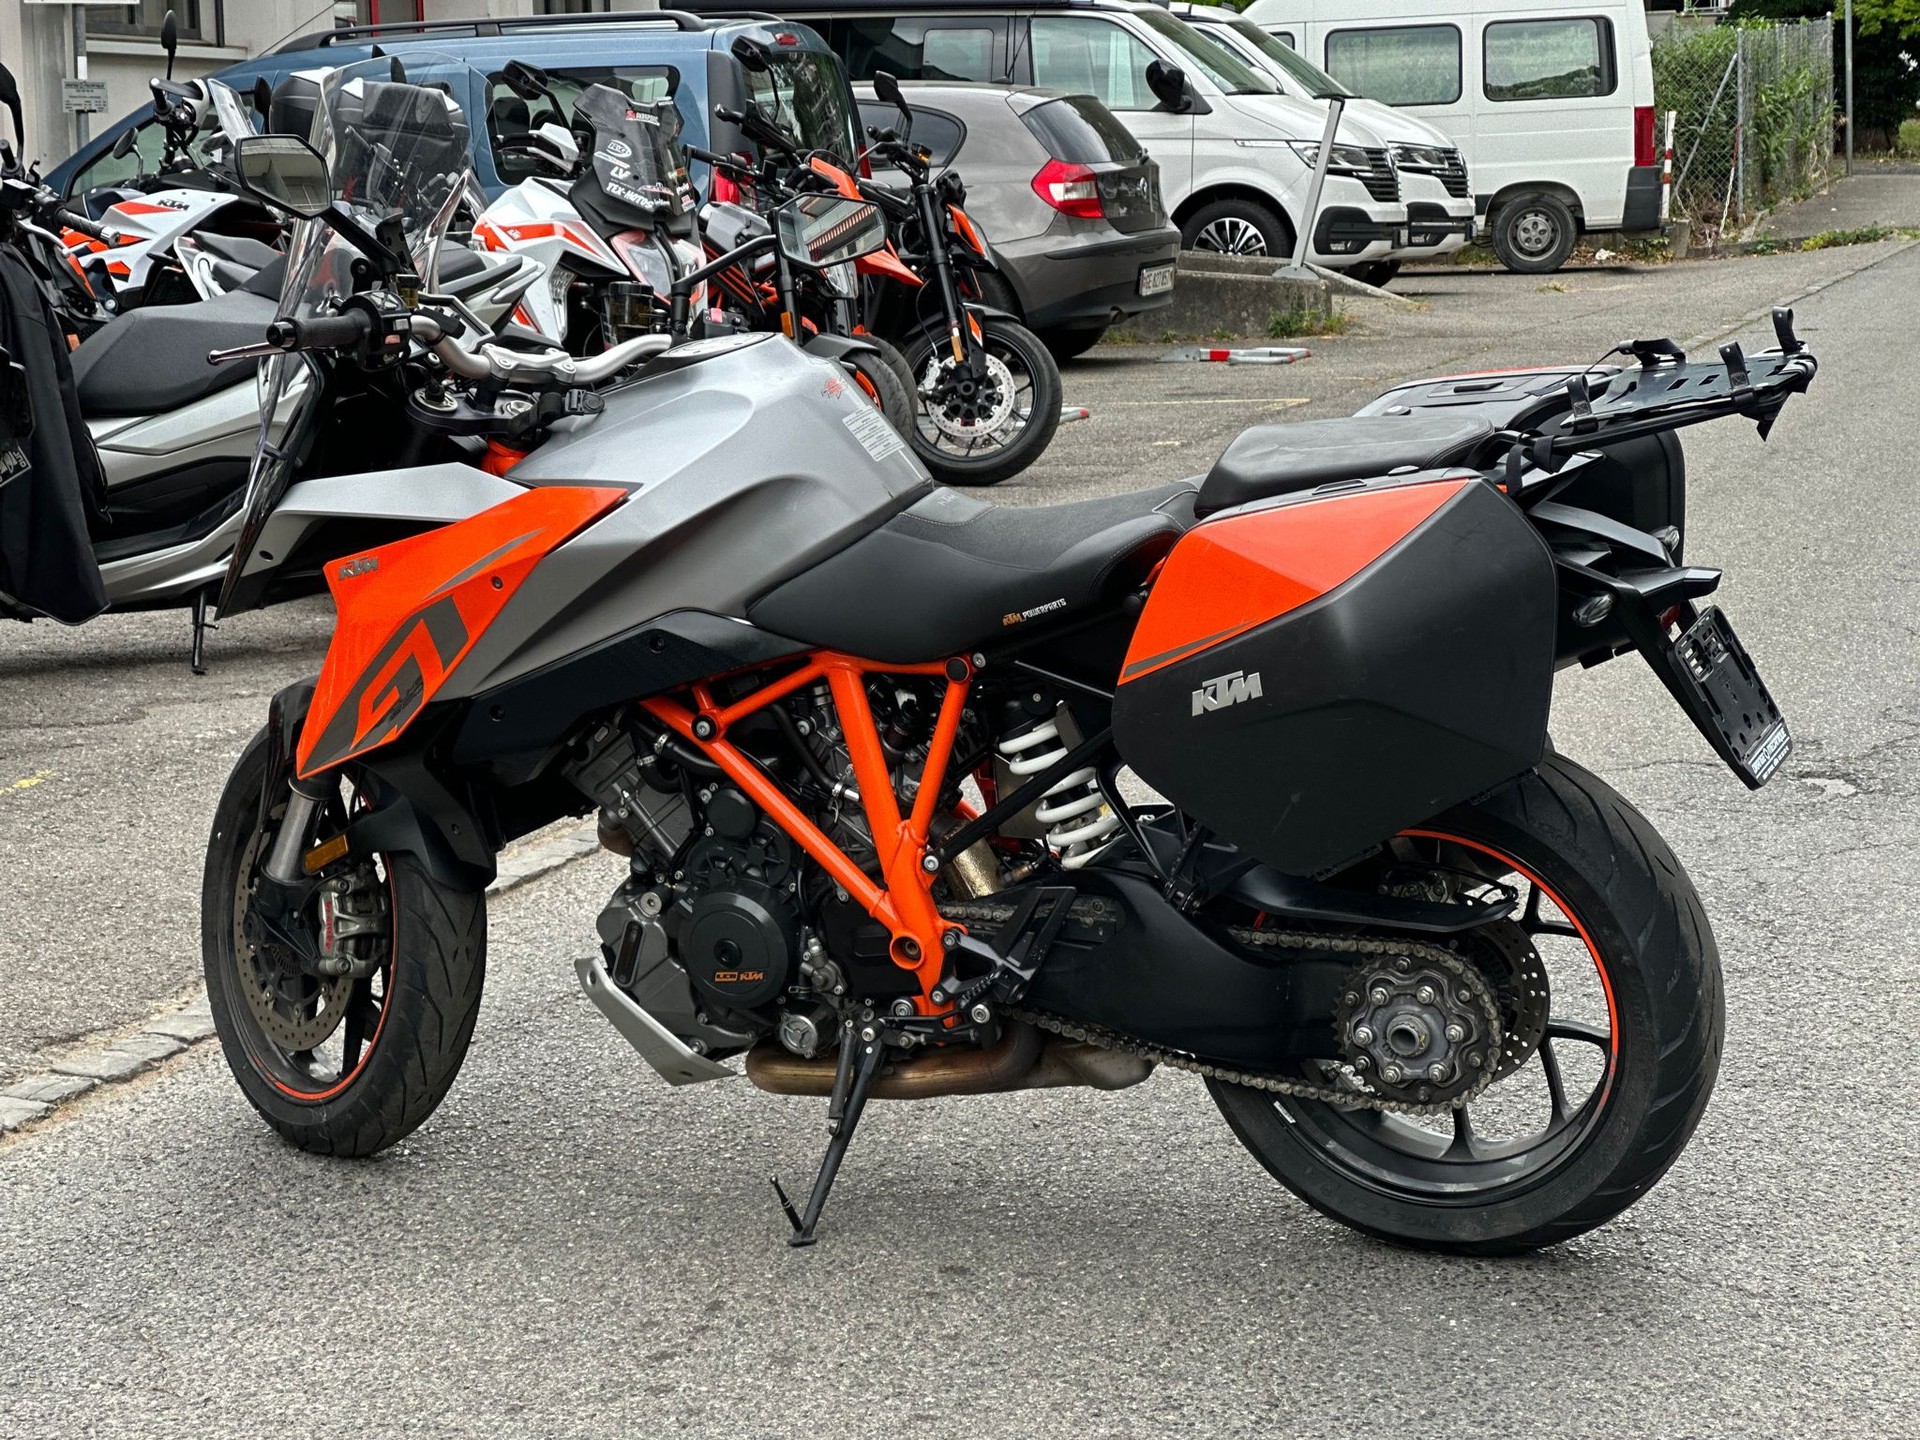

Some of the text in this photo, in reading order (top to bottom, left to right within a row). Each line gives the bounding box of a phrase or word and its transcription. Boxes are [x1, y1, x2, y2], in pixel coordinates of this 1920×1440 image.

[610, 166, 631, 179] LV
[157, 199, 190, 211] KTM
[338, 557, 378, 580] KTM
[1003, 598, 1067, 626] KTM POWERPARTS
[1192, 670, 1263, 717] KTM
[740, 971, 764, 981] KTM
